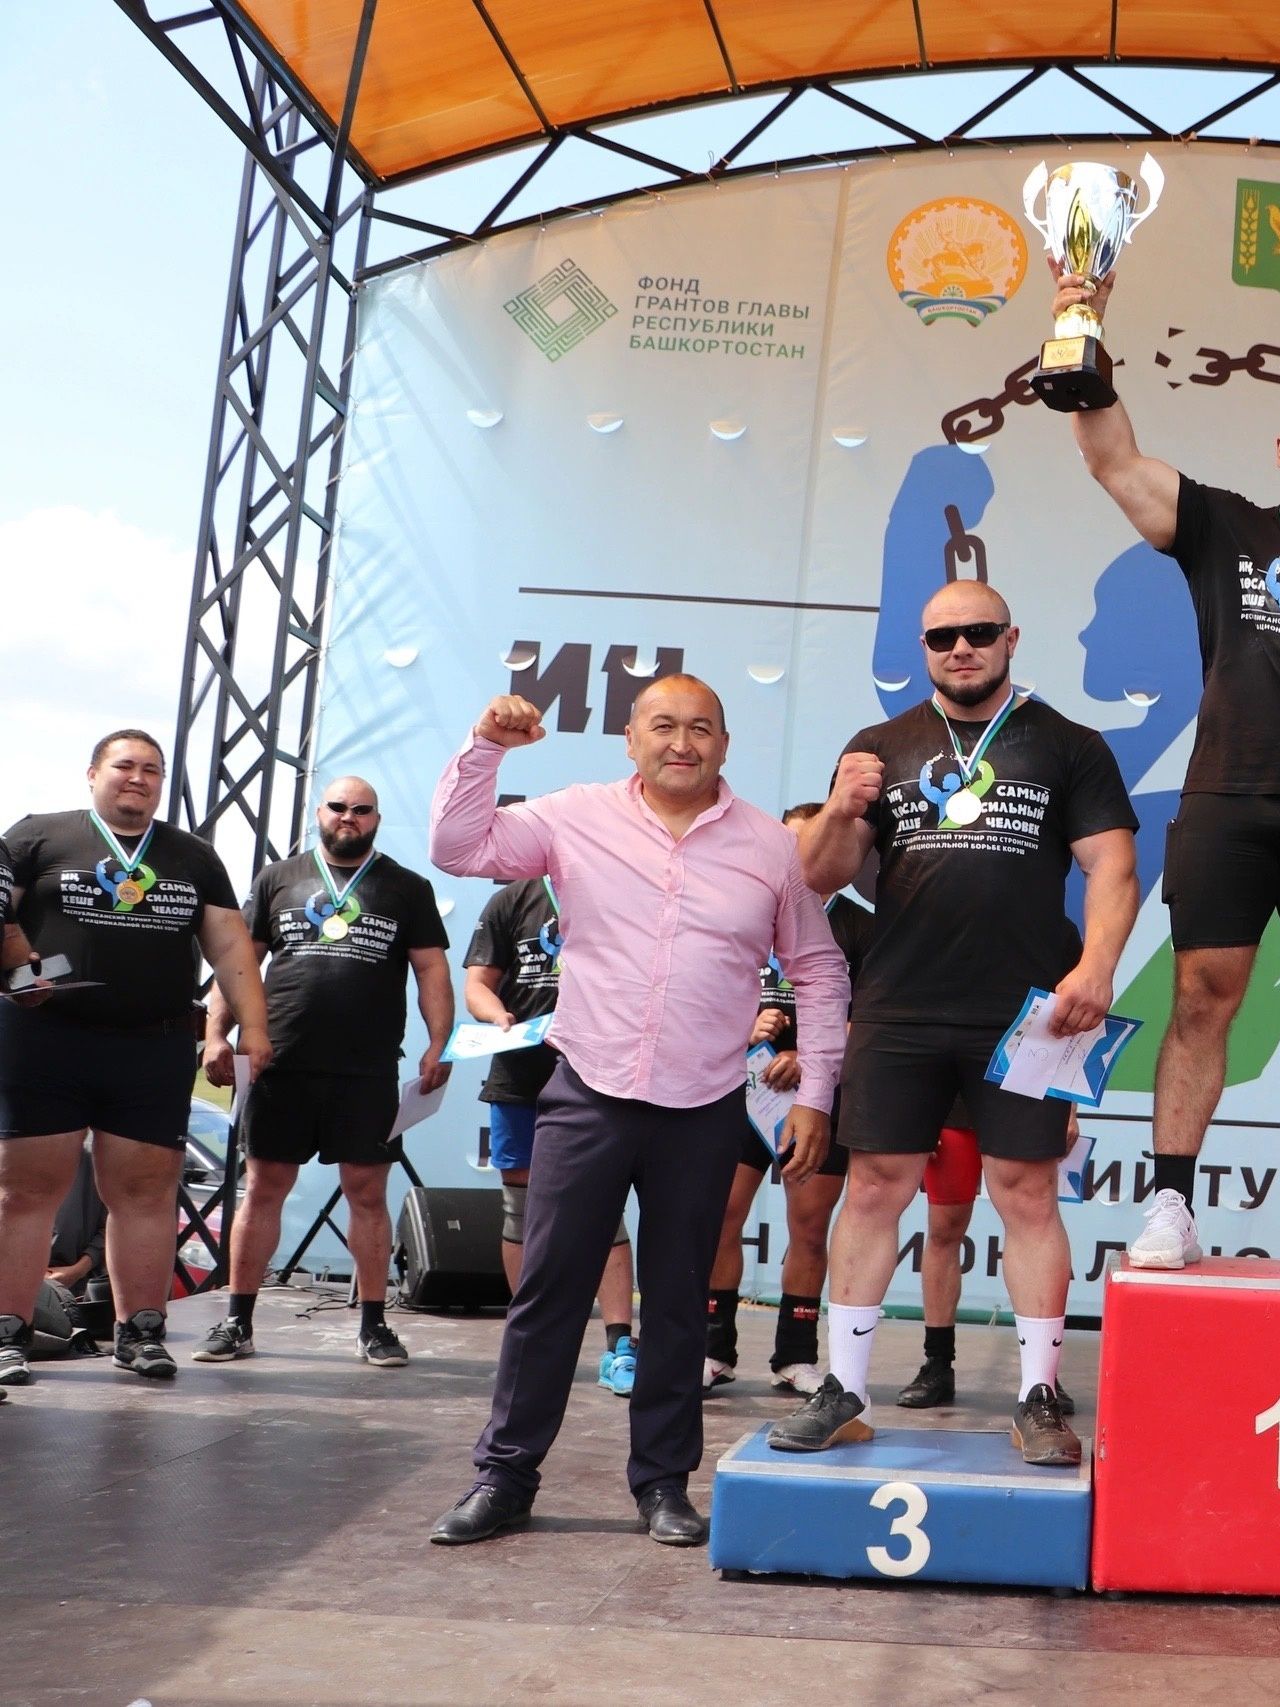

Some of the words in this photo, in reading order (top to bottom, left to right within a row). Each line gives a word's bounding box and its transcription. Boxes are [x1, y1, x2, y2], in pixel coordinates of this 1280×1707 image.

[638, 276, 700, 295] ФОНД
[635, 295, 730, 314] ГРАНТОВ
[737, 301, 810, 320] ГЛАВЫ
[632, 315, 774, 337] РЕСПУБЛИКИ
[629, 335, 805, 359] БАШКОРТОСТАН
[996, 786, 1049, 806] САМЫЙ
[981, 801, 1044, 821] СИЛЬНЫЙ
[985, 817, 1040, 836] ЧЕЛОВЕК
[866, 1481, 931, 1578] 3
